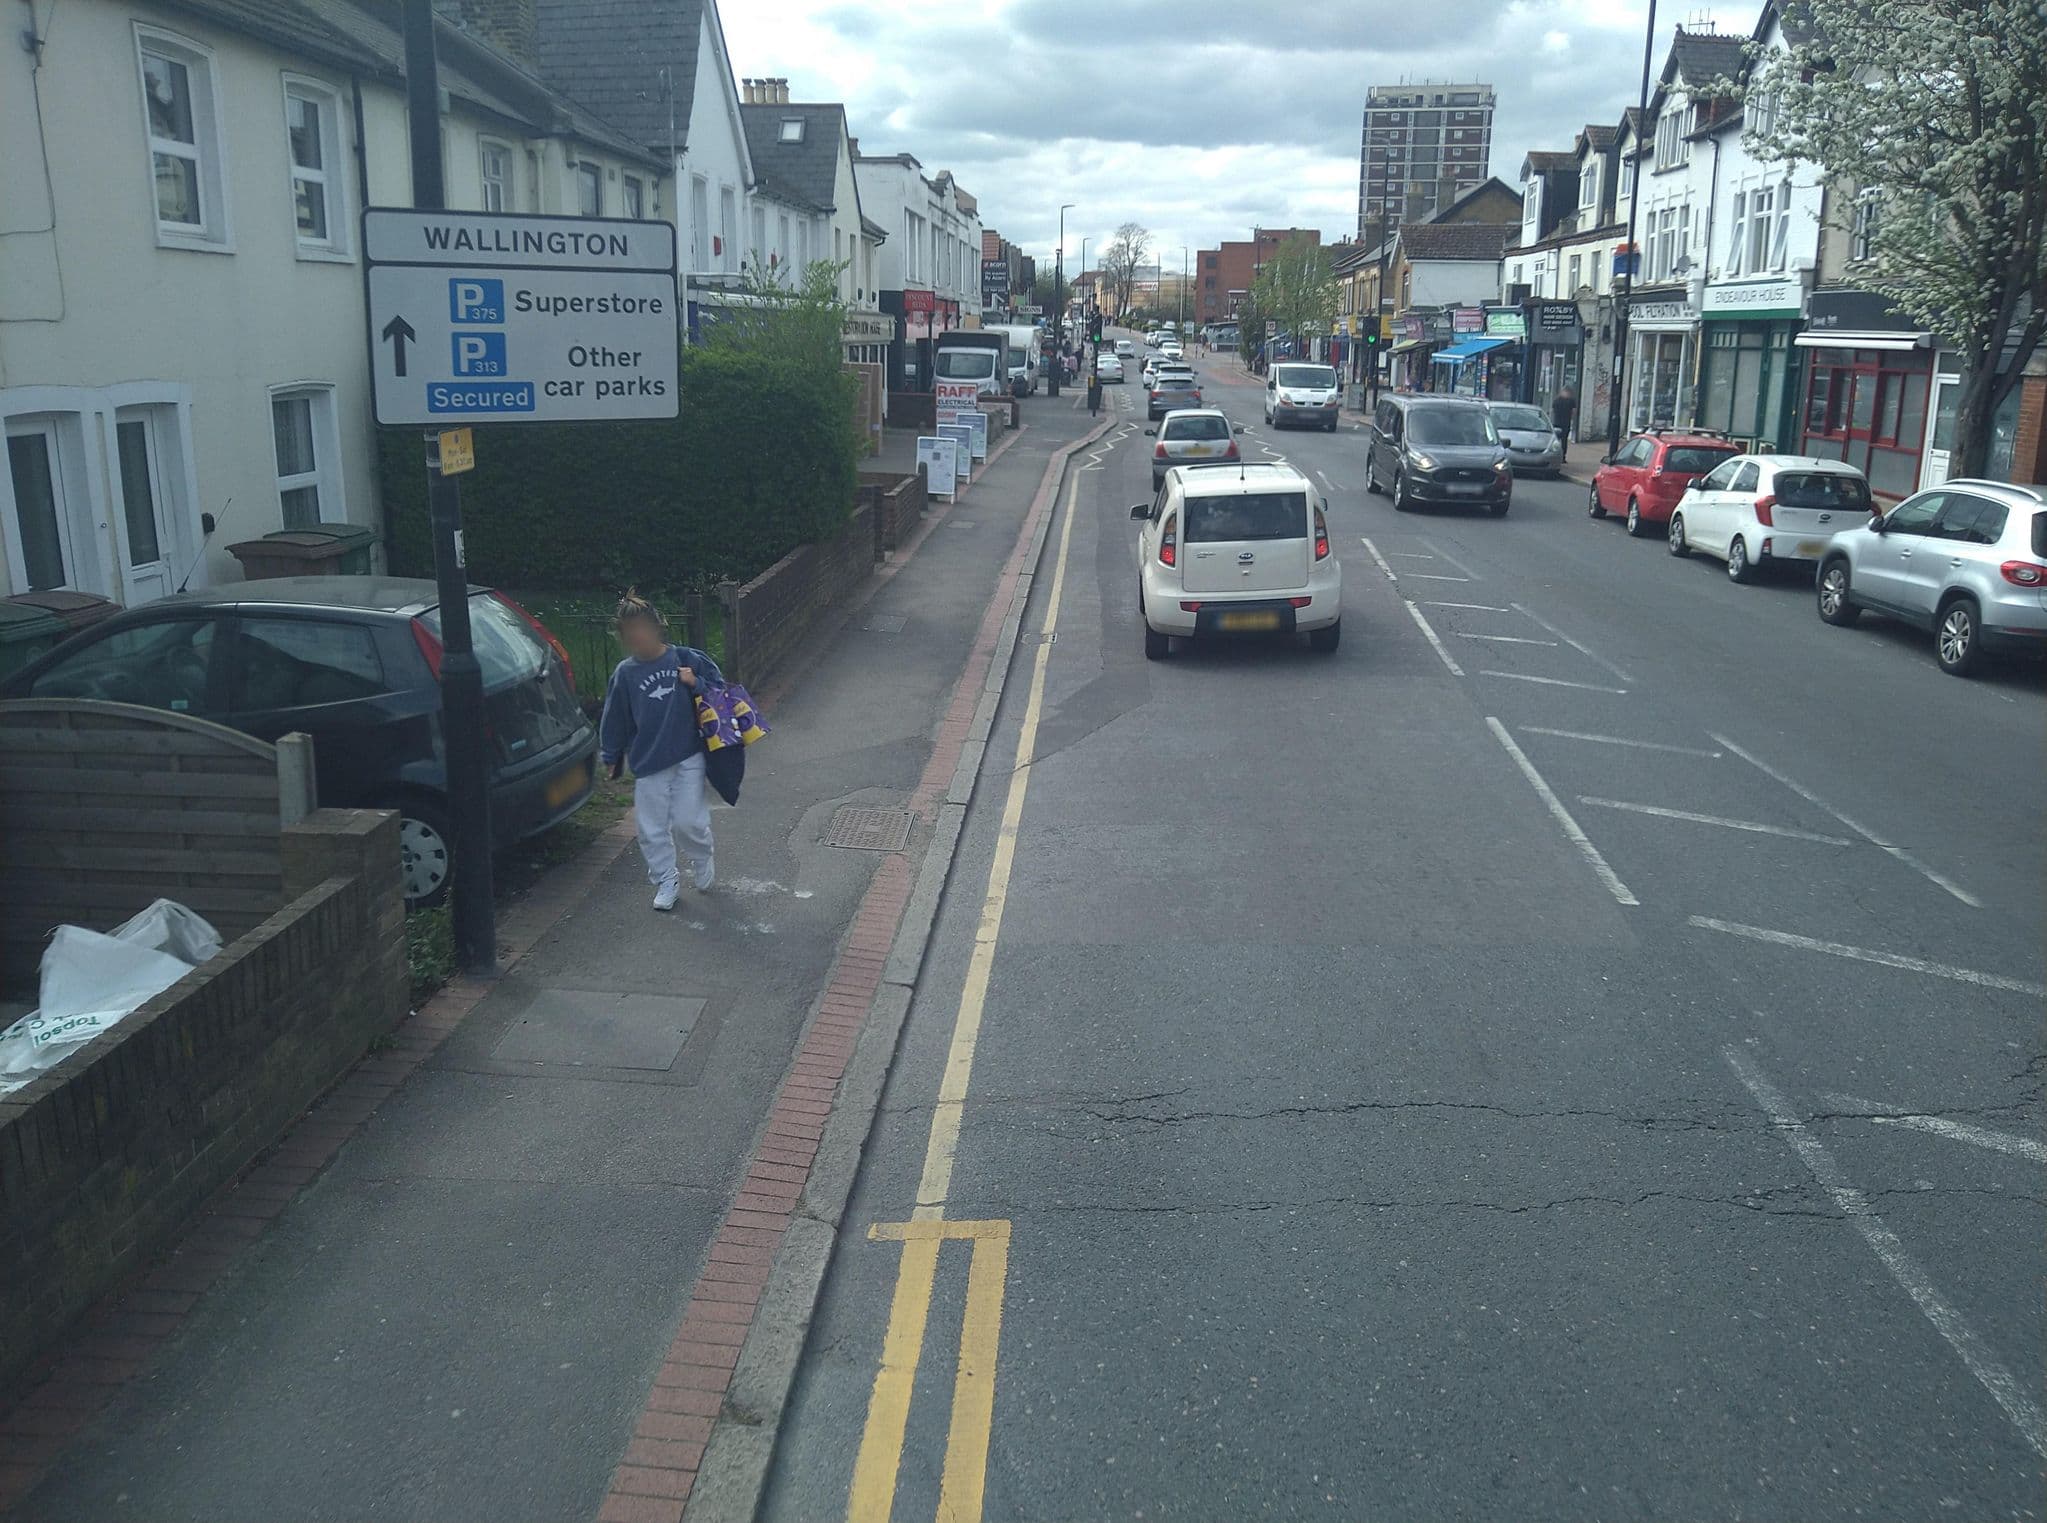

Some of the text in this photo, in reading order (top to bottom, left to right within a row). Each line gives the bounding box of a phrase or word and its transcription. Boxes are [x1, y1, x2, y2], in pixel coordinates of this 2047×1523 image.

[424, 226, 629, 257] WALLINGTON
[456, 283, 497, 320] P 375
[515, 290, 663, 316] Superstore
[1714, 287, 1786, 304] ENDEAVOUR HOUSE
[1645, 303, 1680, 318] FILTRATION
[459, 337, 498, 373] P 313
[568, 346, 642, 368] Other
[434, 388, 528, 408] Secured
[544, 376, 666, 400] car parks
[937, 386, 976, 398] RAFF
